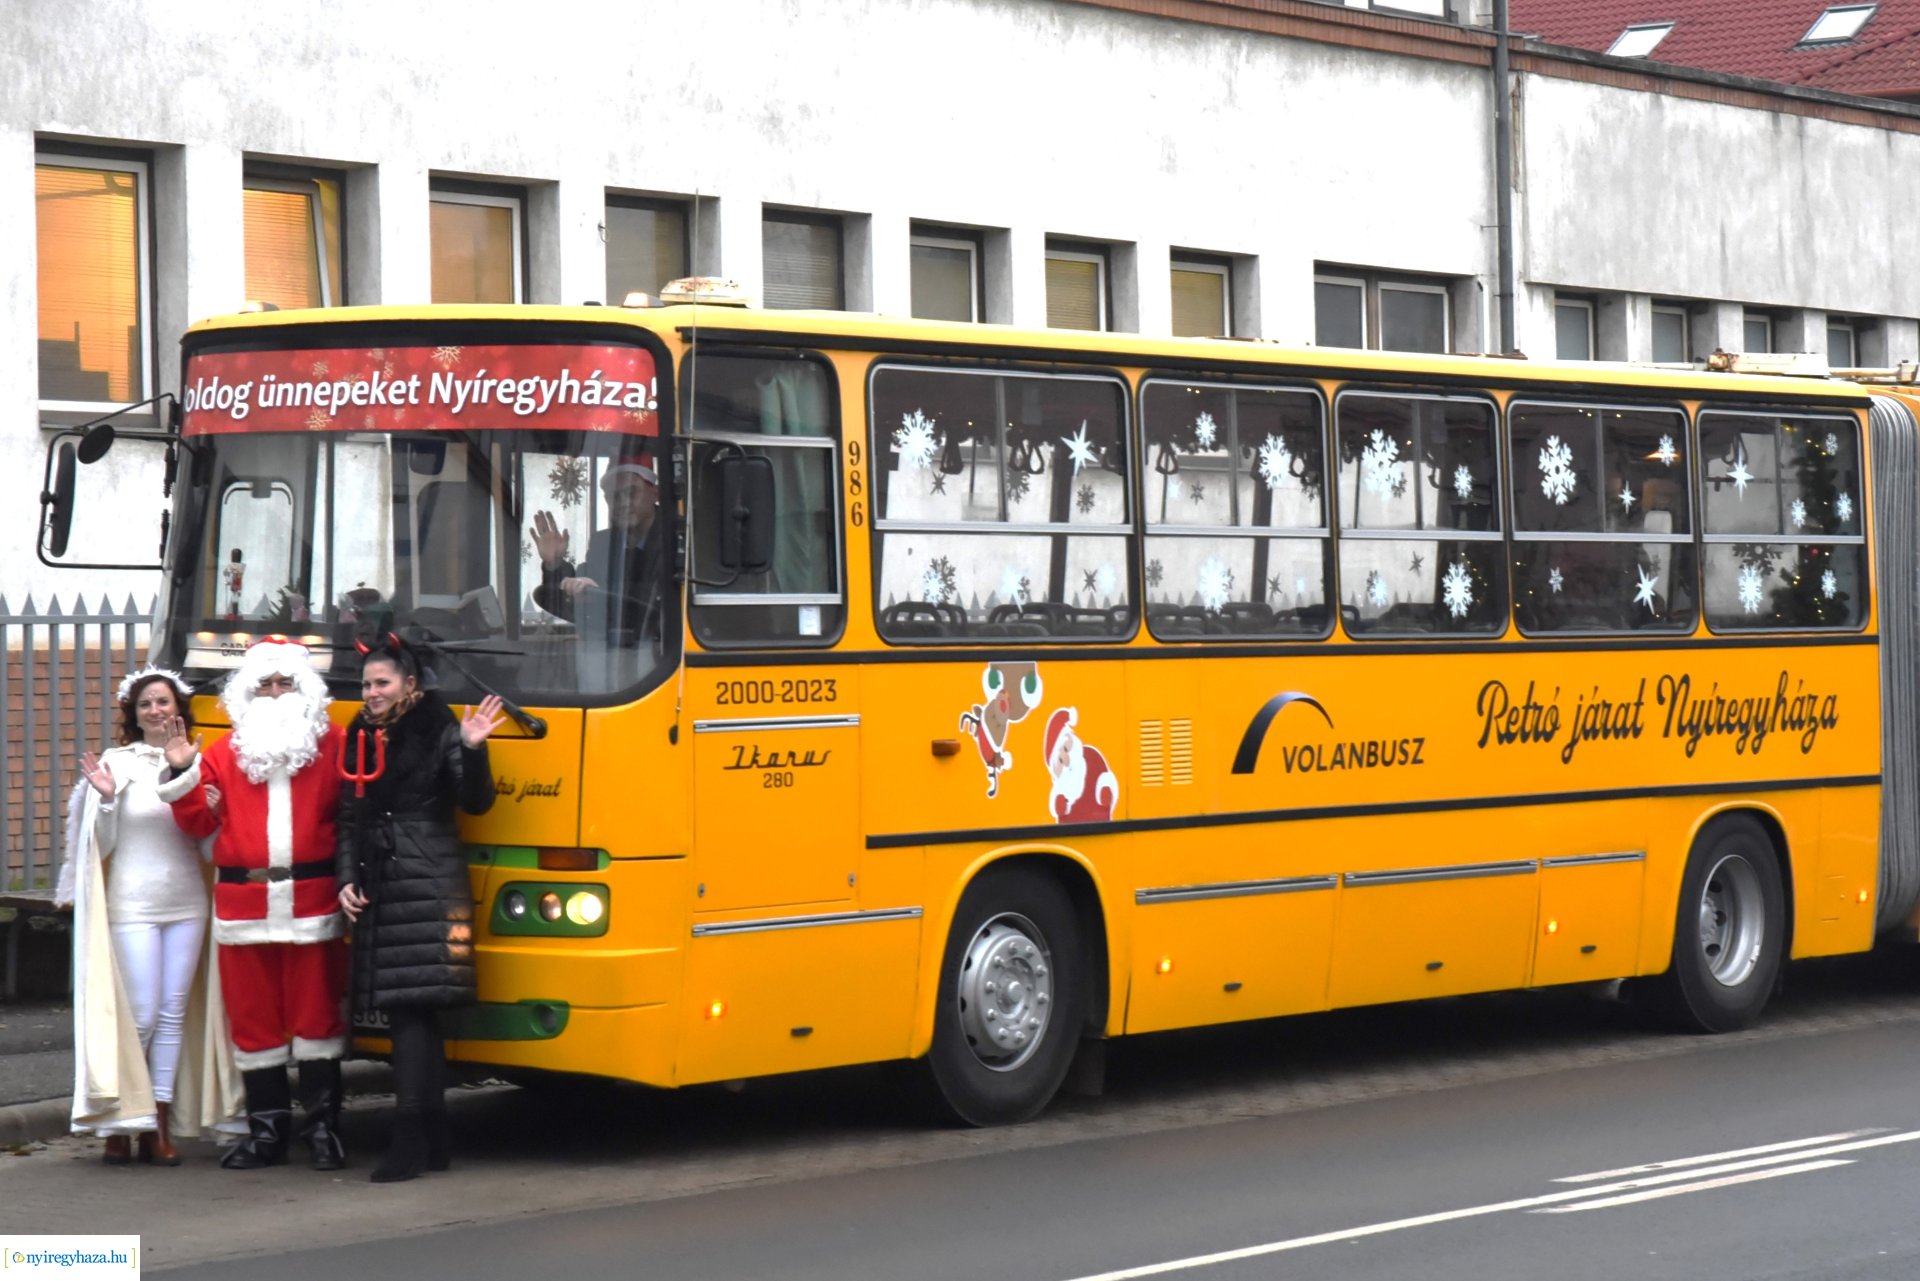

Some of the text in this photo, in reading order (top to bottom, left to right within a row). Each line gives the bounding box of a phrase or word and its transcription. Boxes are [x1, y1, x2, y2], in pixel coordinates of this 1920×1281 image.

[184, 368, 659, 420] oldog ünnepeket Nyíregyháza!
[848, 440, 863, 527] 986
[716, 679, 837, 705] 2000-2023
[1476, 669, 1840, 765] Retró járat Nyíregyháza
[722, 745, 832, 770] Ikarus
[1282, 737, 1425, 774] VOLÁNBUSZ
[763, 772, 794, 789] 280
